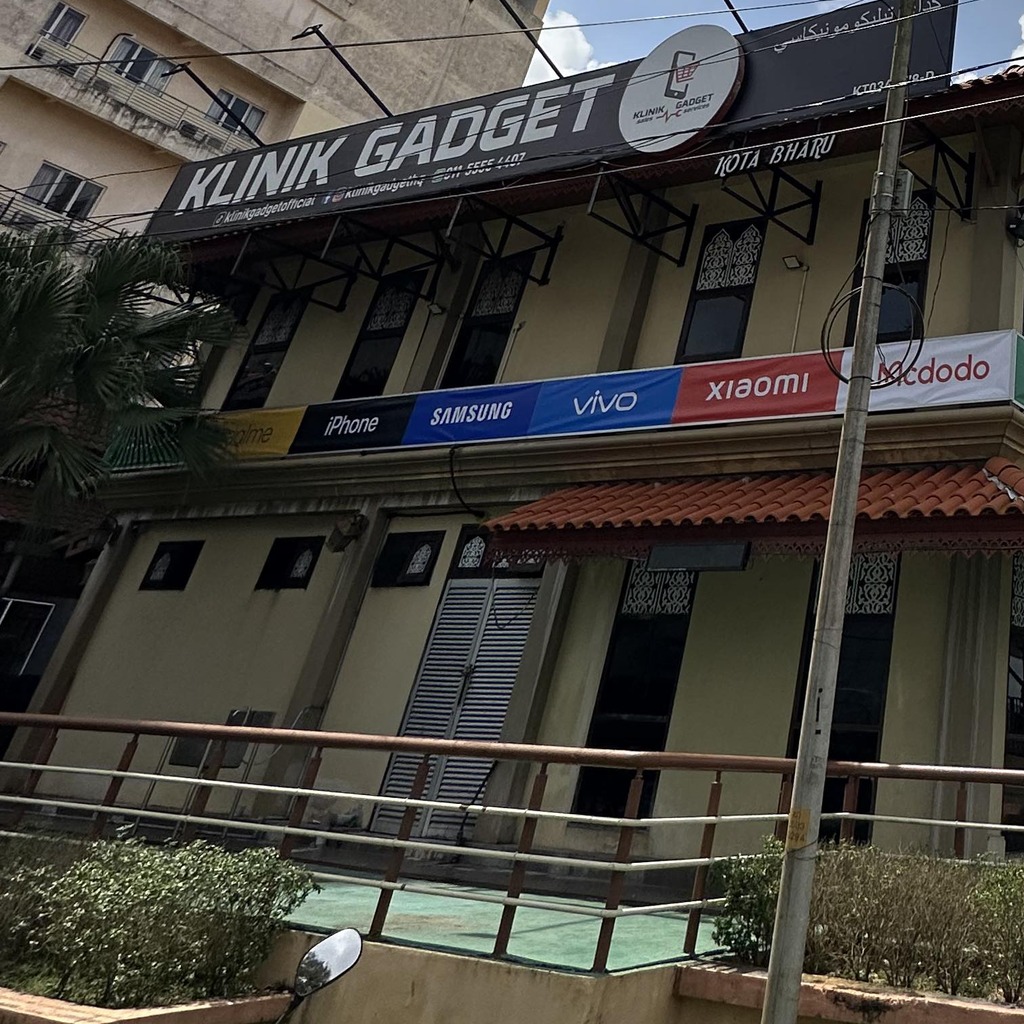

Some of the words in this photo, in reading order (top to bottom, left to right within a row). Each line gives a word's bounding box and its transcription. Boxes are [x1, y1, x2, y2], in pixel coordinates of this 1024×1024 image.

[632, 105, 666, 120] KLINIK
[675, 93, 714, 109] GADGET
[175, 136, 349, 215] KLINIK
[354, 74, 616, 178] GADGET
[714, 149, 761, 177] KOTA
[768, 134, 836, 164] BHARU
[877, 354, 989, 386] Mcdodo
[705, 371, 809, 401] xiaomi
[430, 401, 512, 426] SAMSUNG
[573, 389, 638, 415] vivo
[323, 414, 378, 436] iPhone
